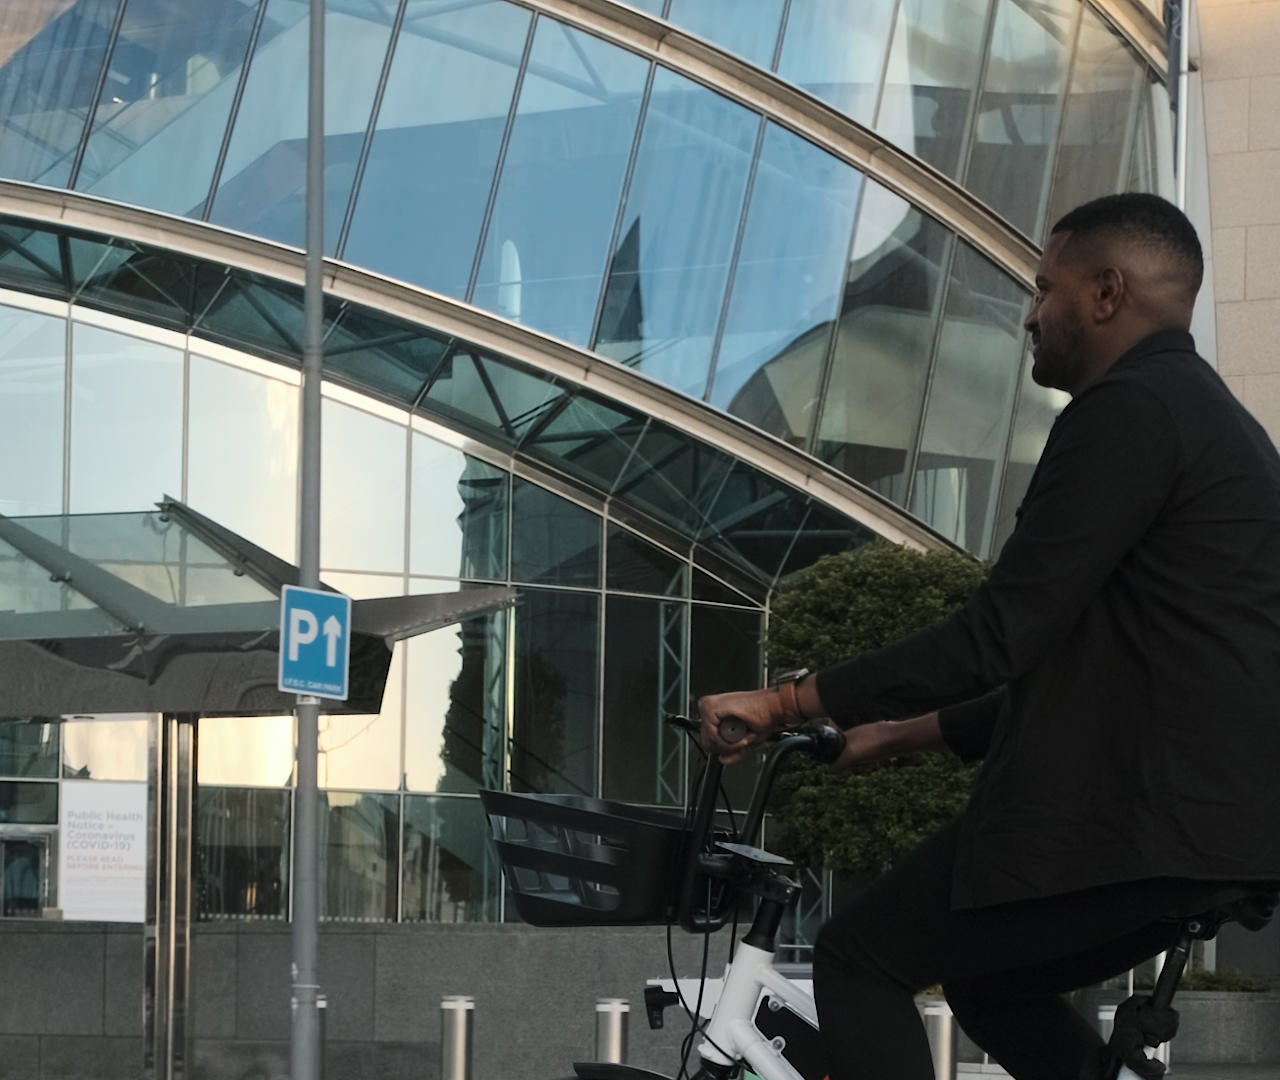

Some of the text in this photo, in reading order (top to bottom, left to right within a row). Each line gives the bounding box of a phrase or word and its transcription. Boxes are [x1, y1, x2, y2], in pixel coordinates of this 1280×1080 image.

[288, 607, 318, 661] P
[66, 810, 144, 823] Public Health
[66, 821, 104, 830] Notice
[66, 830, 135, 841] Coronavirus
[66, 840, 131, 851] (COVID-19)
